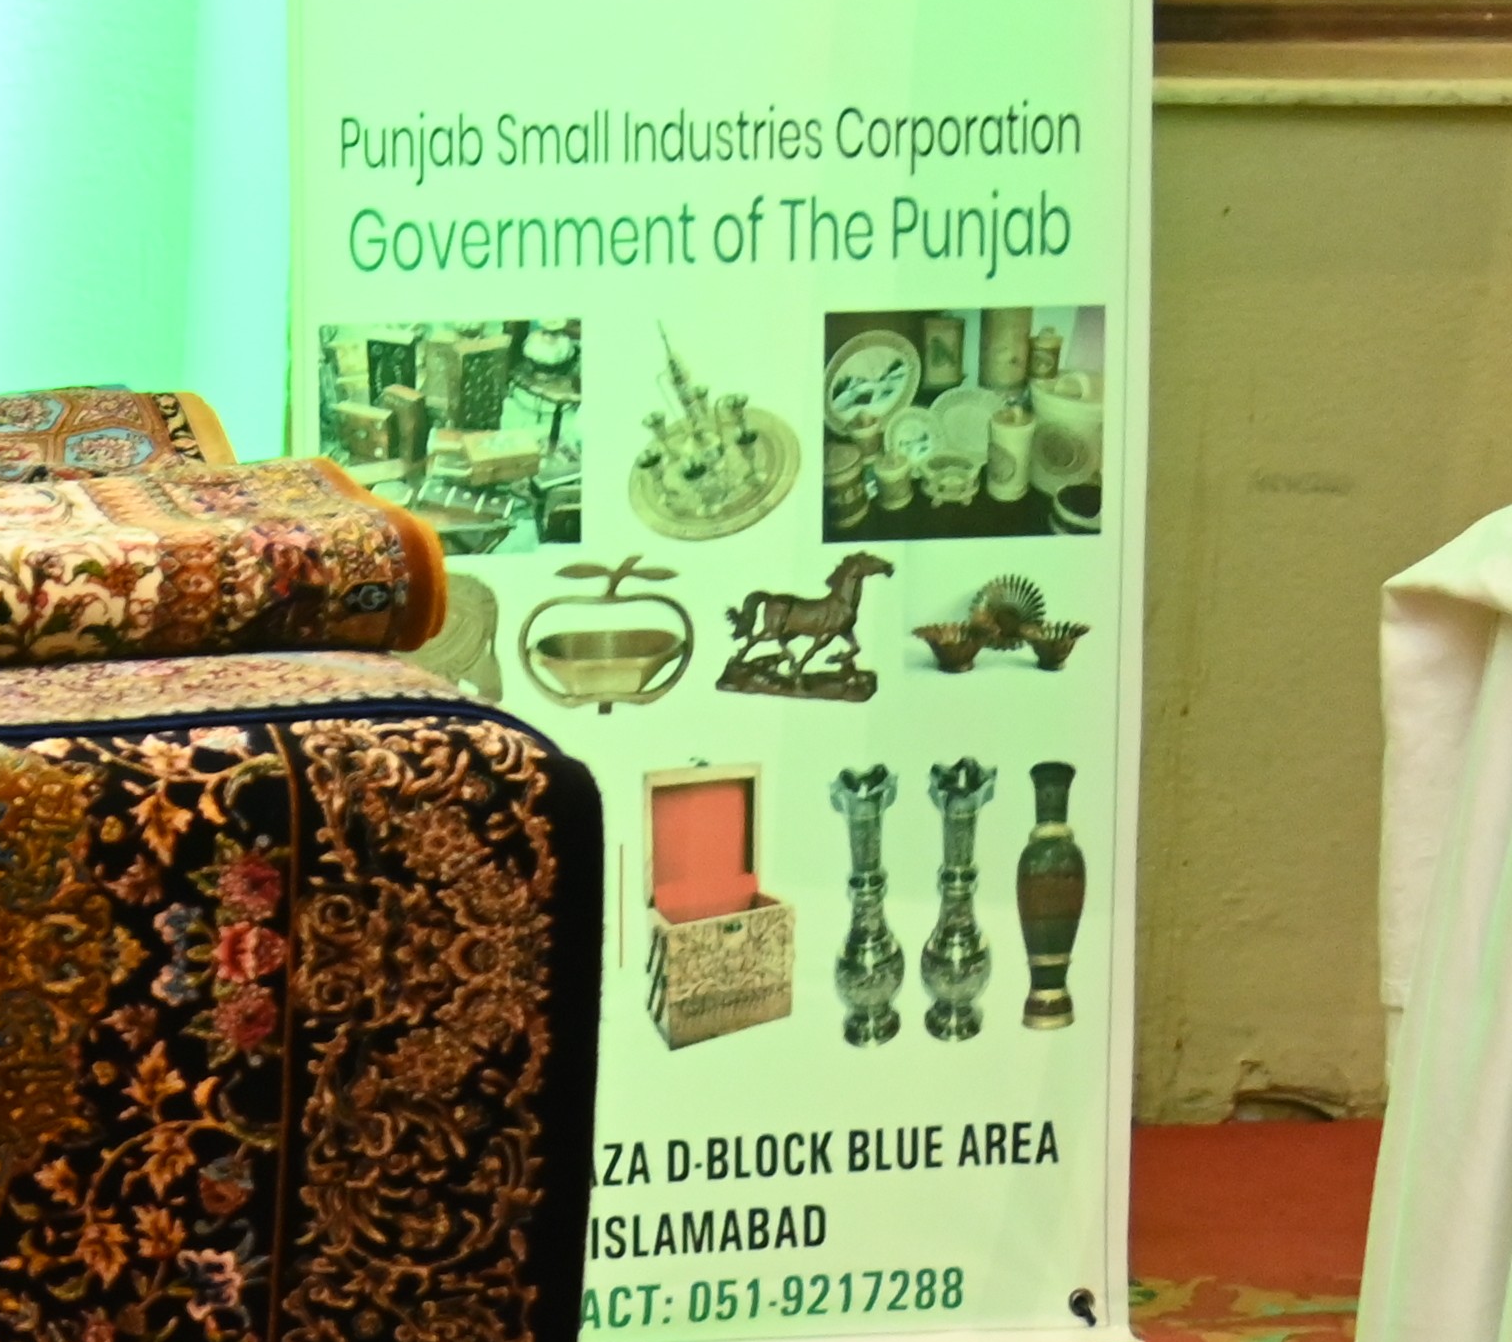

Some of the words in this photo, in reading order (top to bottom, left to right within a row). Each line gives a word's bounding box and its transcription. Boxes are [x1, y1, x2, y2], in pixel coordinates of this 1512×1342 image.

[340, 110, 485, 187] Punjab
[496, 108, 610, 167] Small
[623, 103, 824, 164] Industries
[835, 98, 1082, 178] Corporation
[348, 201, 698, 275] Government
[712, 193, 767, 266] of
[779, 193, 875, 263] The
[891, 188, 1072, 280] Punjab
[666, 1129, 835, 1185] D-BLOCK
[846, 1123, 944, 1175] BLUE
[956, 1119, 1061, 1169] AREA
[590, 1202, 828, 1262] ISLAMABAD
[686, 1265, 965, 1325] 051-9217288
